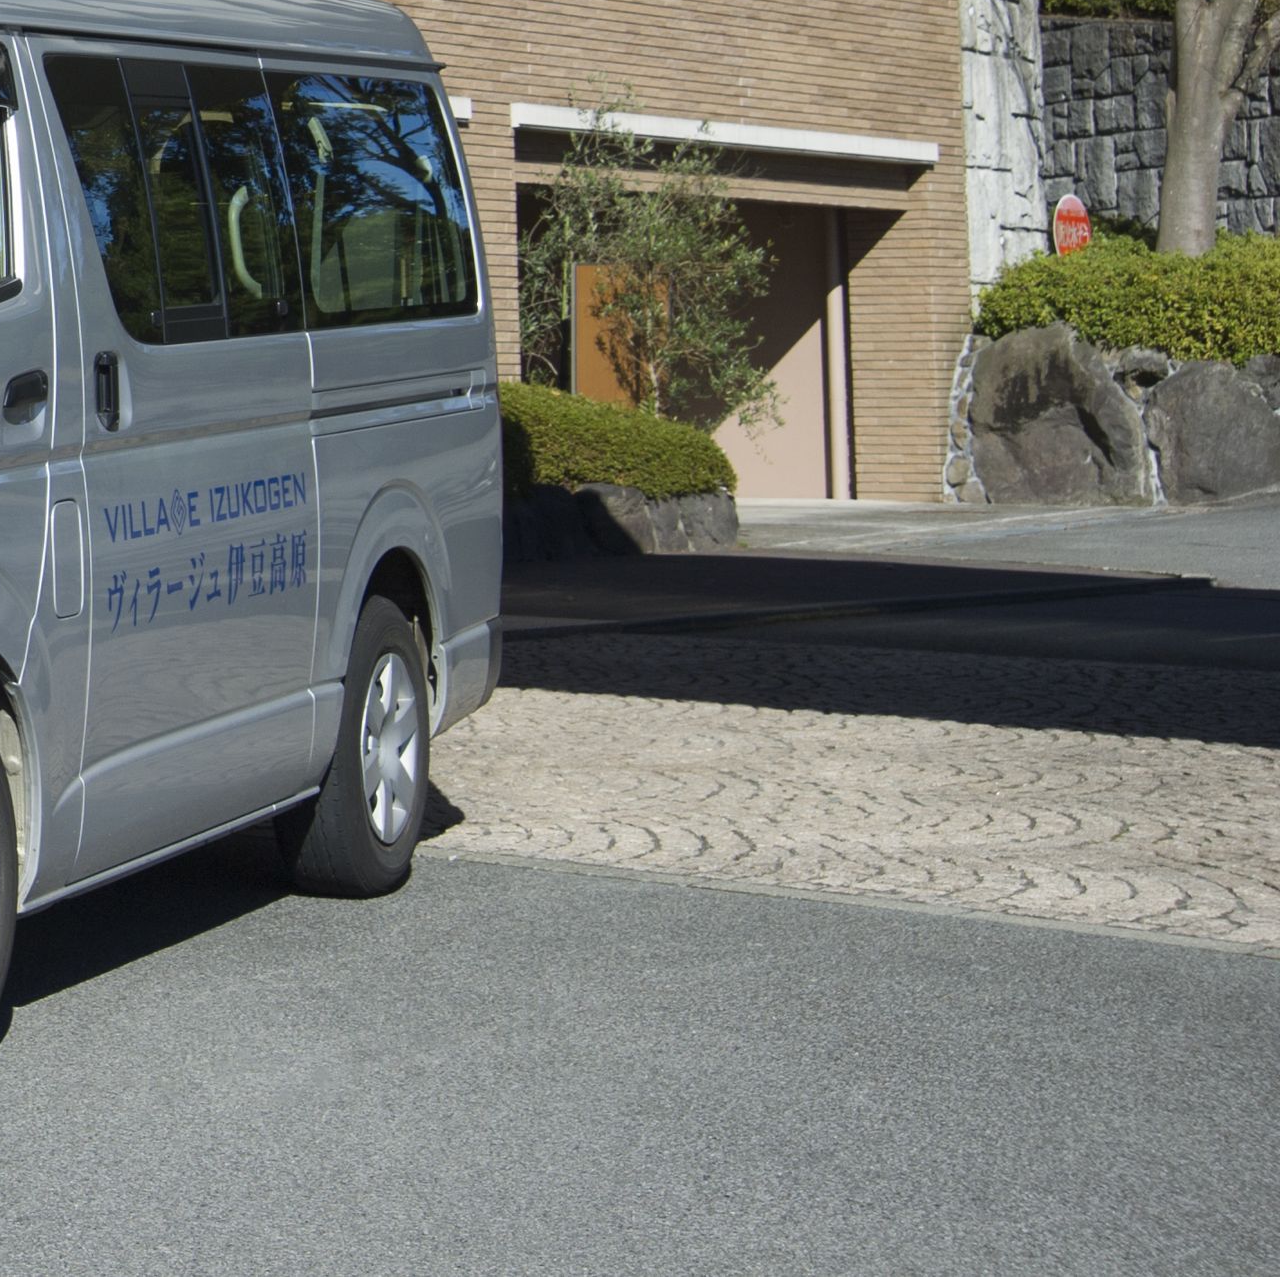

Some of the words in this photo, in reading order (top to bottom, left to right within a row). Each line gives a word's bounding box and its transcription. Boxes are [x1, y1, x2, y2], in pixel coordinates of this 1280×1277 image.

[103, 488, 201, 544] VILLAGE
[209, 472, 307, 523] IZUKOGEN
[107, 530, 307, 634] ヴィラージュ伊豆高原
